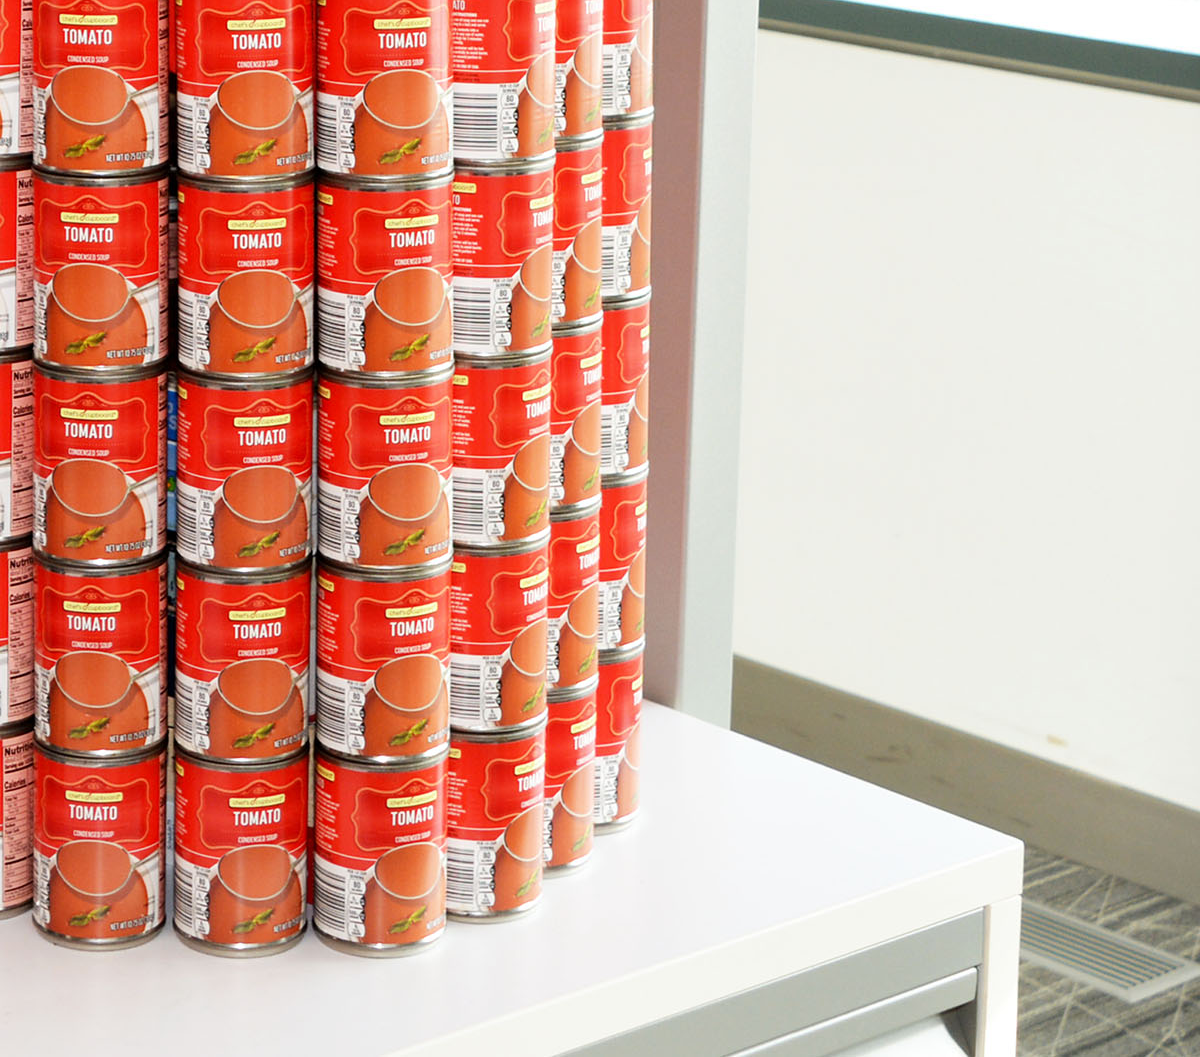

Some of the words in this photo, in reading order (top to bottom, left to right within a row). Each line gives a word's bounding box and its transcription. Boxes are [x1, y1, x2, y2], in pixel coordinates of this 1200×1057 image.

[63, 28, 112, 45] TOMATO
[232, 33, 281, 49] TOMATO
[378, 32, 427, 49] TOMATO
[67, 55, 95, 64] CONDENSED
[95, 55, 109, 64] SOUP
[64, 226, 113, 242] TOMATO
[232, 233, 281, 249] TOMATO
[389, 229, 435, 248] TOMATO
[64, 422, 112, 438] TOMATO
[238, 429, 286, 446] TOMATO
[384, 426, 431, 444] TOMATO
[67, 615, 115, 631] TOMATO
[233, 622, 281, 639] TOMATO
[390, 617, 435, 636] TOMATO
[69, 804, 117, 821] TOMATO
[233, 808, 280, 826] TOMATO
[390, 805, 434, 827] TOMATO
